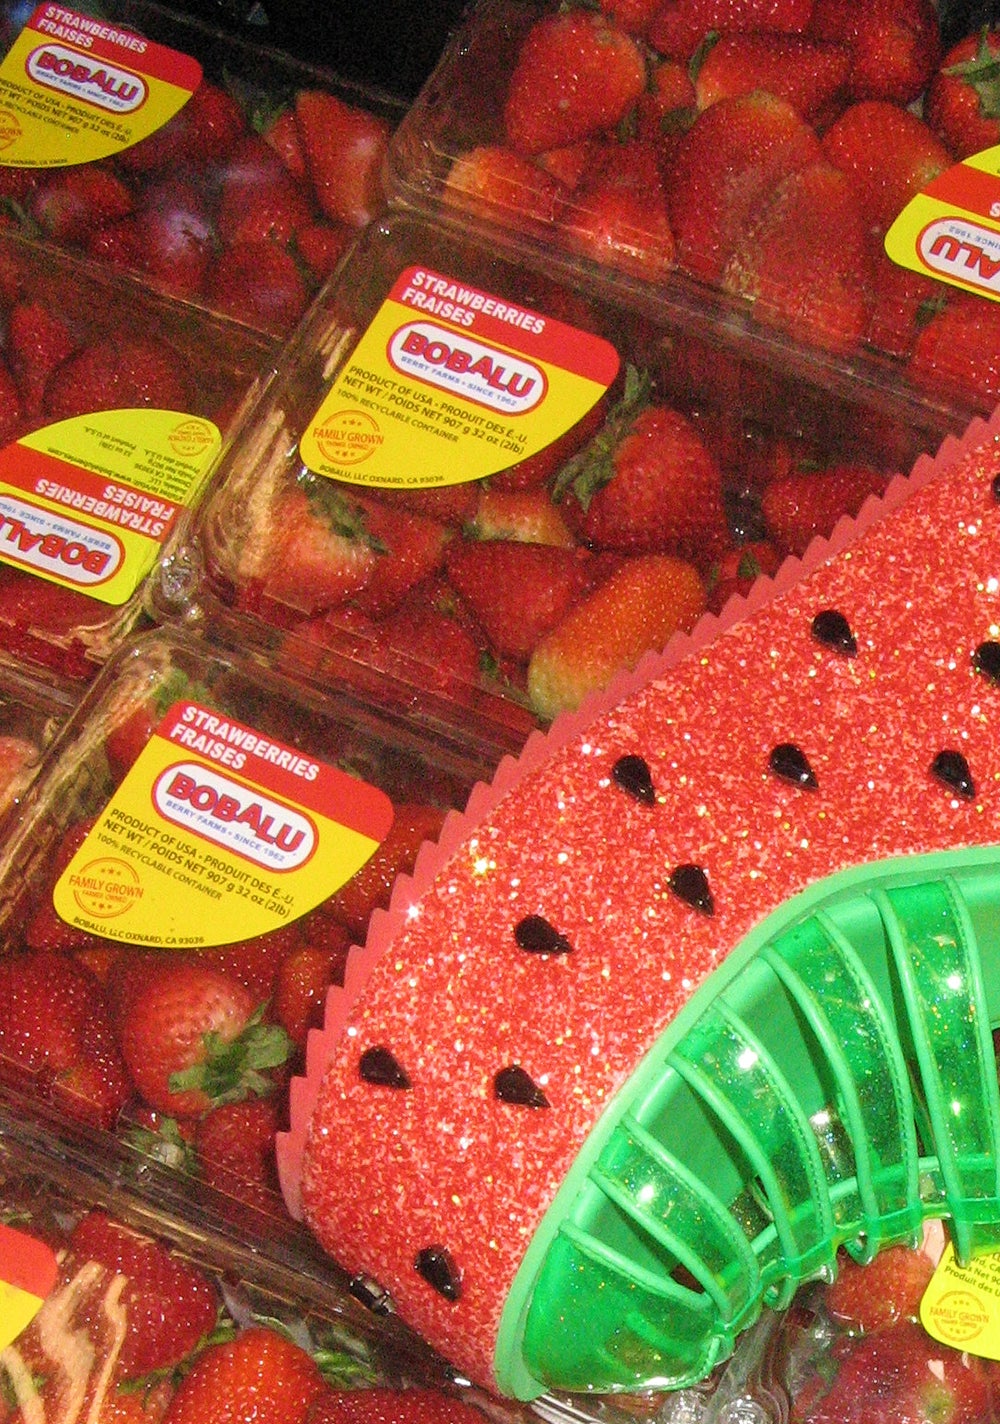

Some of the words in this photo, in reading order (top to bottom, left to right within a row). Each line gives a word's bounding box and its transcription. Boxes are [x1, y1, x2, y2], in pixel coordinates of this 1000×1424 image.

[36, 18, 94, 48] FRAISES
[45, 6, 147, 53] STRAWBERRIES
[35, 50, 139, 101] BOBALU
[401, 287, 475, 326] FRAISES
[411, 271, 545, 334] STRAWBERRIES
[400, 330, 536, 398] BOBALU
[348, 366, 398, 390] PRODUCT
[397, 386, 412, 396] OF
[412, 392, 432, 406] USA
[439, 403, 485, 426] PRODUIT
[484, 421, 505, 435] DES
[35, 479, 164, 538] STRAWBERRIES
[103, 484, 175, 522] FRAISES
[0, 513, 111, 576] BOBAL
[170, 722, 246, 769] FRAISES
[182, 705, 320, 781] STRAWBERRIES
[166, 771, 306, 852] BOBALU
[110, 808, 161, 838] PRODUCT
[160, 833, 176, 845] OF
[175, 840, 196, 857] USA
[203, 854, 251, 882] PRODUIT
[249, 877, 271, 894] DES
[943, 1265, 976, 1285] Produit
[977, 1282, 992, 1293] des
[973, 1267, 989, 1280] Net
[989, 1263, 1000, 1273] CA
